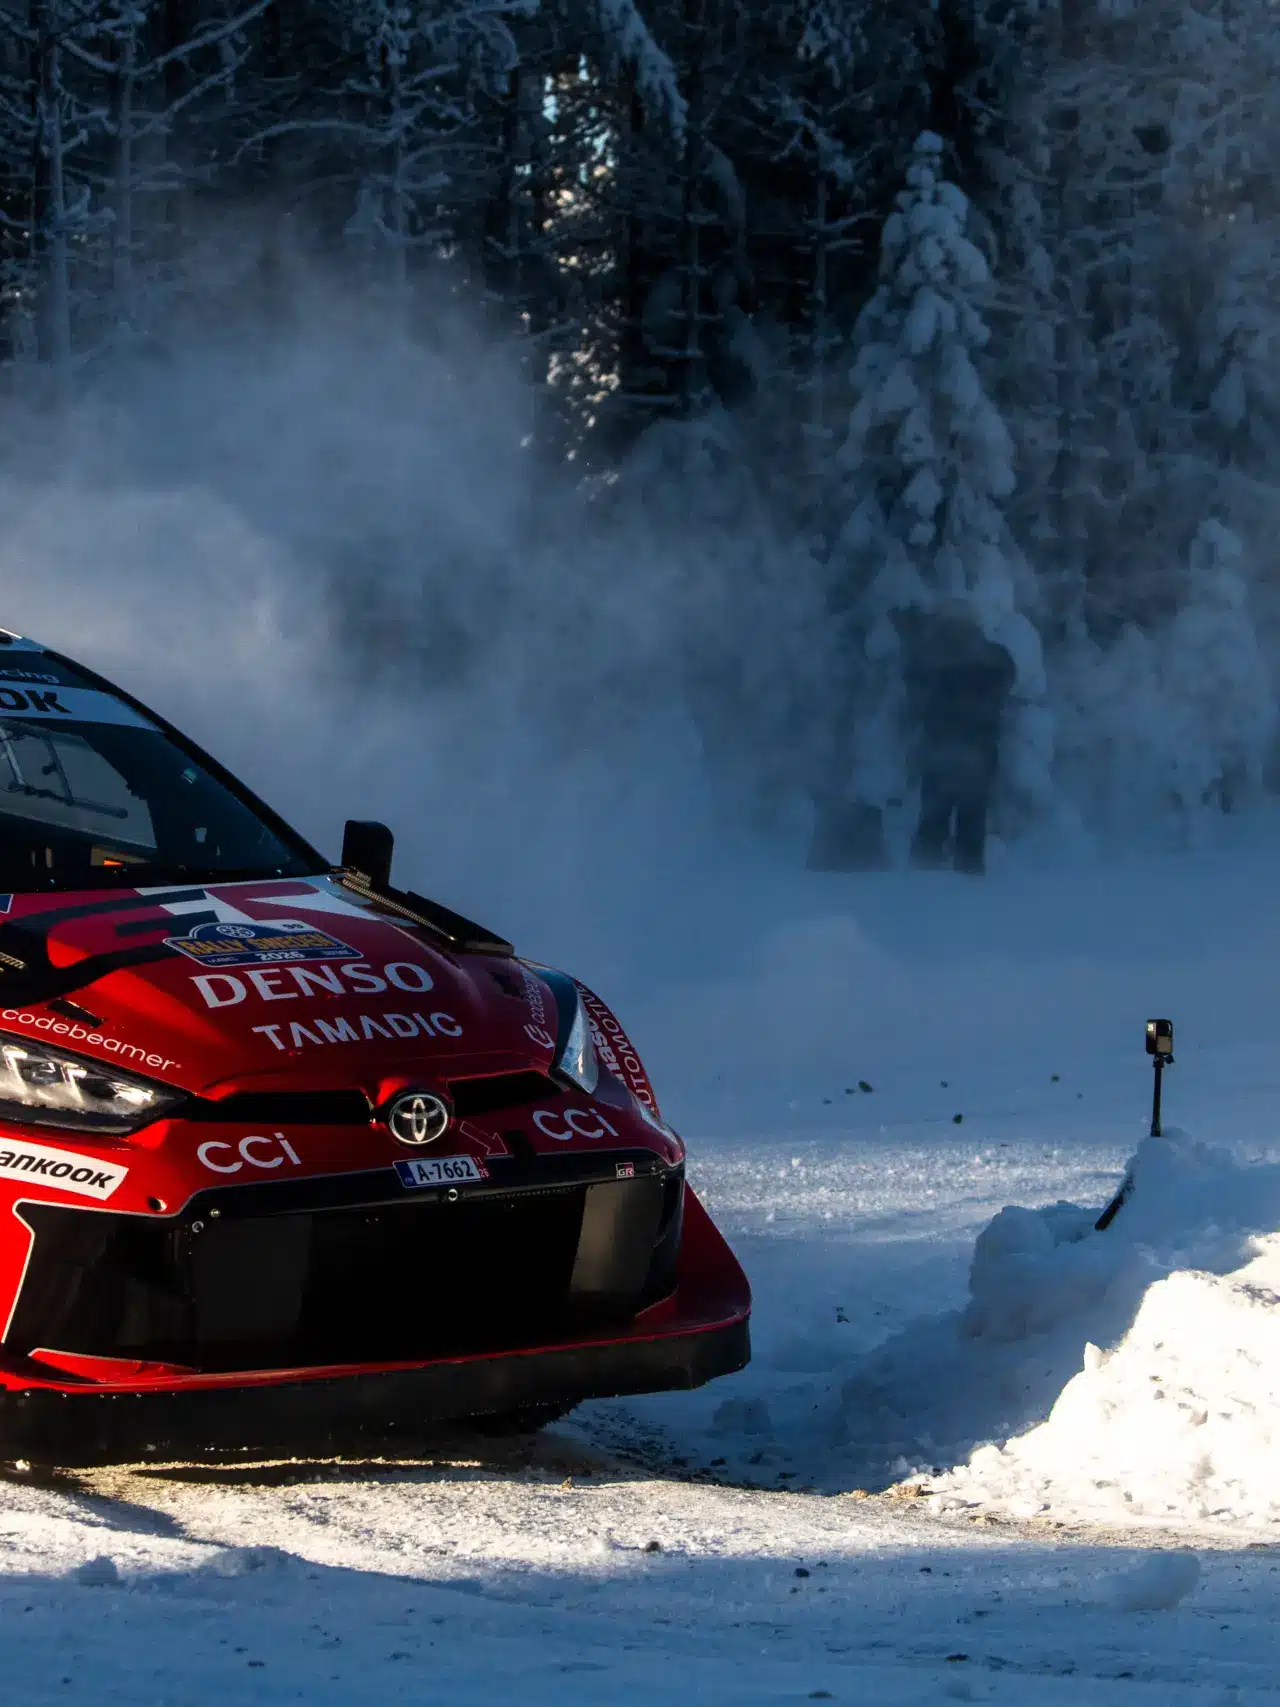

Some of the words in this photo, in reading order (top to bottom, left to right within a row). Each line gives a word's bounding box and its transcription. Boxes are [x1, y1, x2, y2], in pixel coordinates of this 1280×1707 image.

[178, 940, 248, 955] RALLY
[246, 933, 339, 951] SWEDEN
[254, 951, 306, 961] 2026
[189, 962, 435, 1008] DENSO
[2, 1009, 177, 1071] codebeamer
[252, 1012, 463, 1050] TAMADIC
[417, 1159, 474, 1182] A-7662
